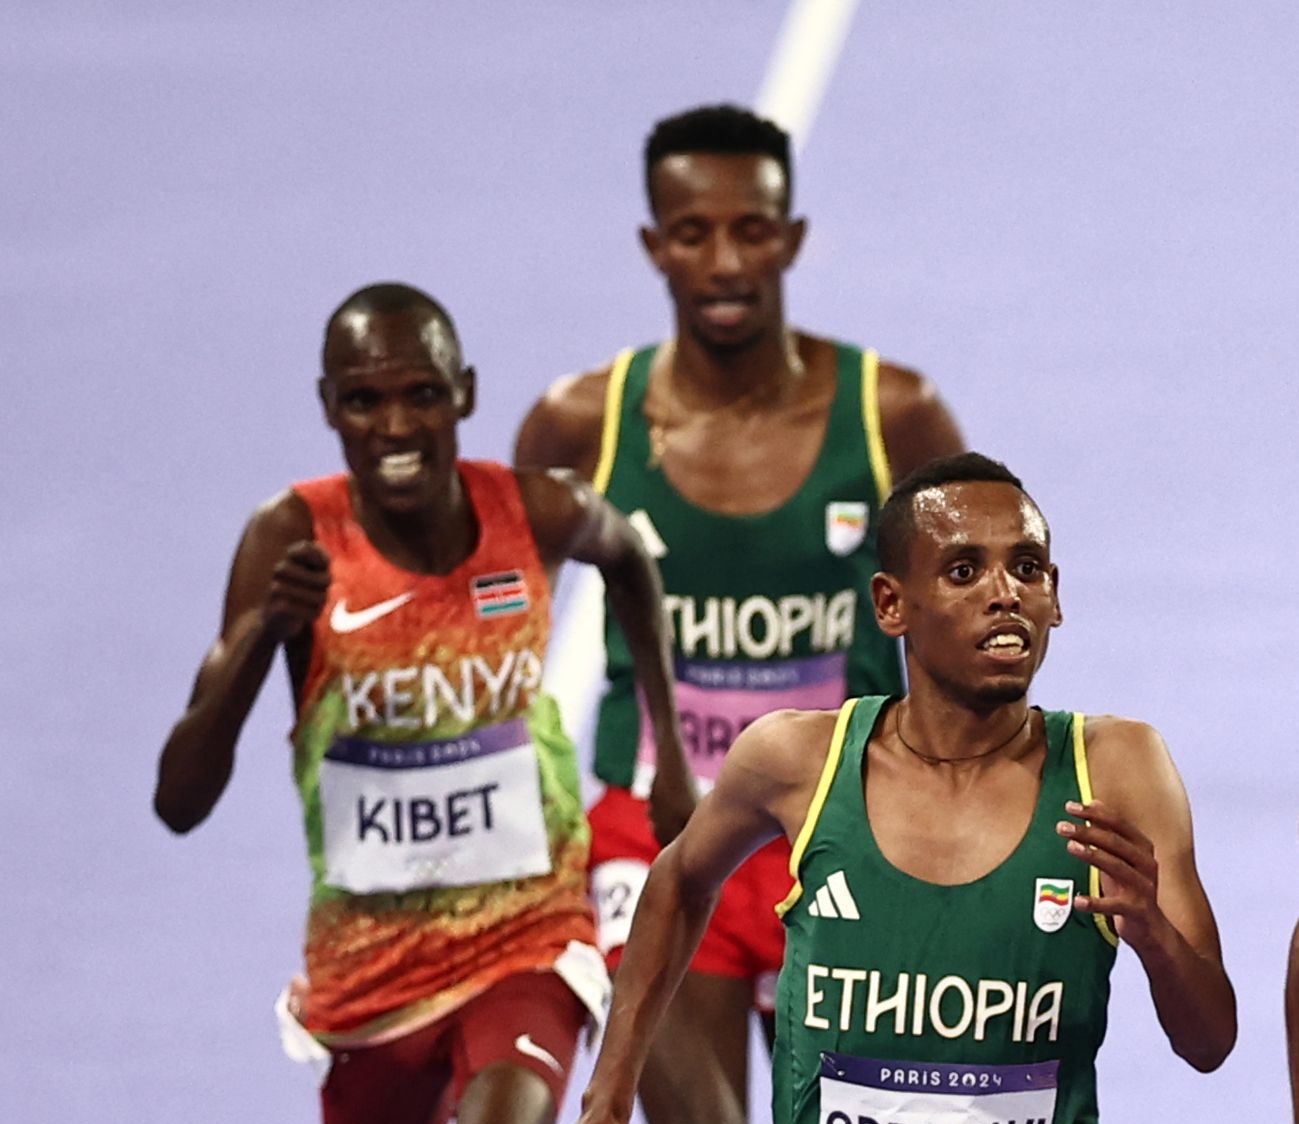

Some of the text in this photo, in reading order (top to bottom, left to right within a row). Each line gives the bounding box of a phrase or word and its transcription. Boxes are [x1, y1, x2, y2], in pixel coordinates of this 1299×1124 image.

[662, 589, 857, 658] THIOPIA
[342, 648, 542, 730] KENYA
[357, 782, 500, 843] KIBET
[804, 964, 1063, 1042] ETHIOPIA
[880, 1068, 1002, 1087] PARIS 2024
